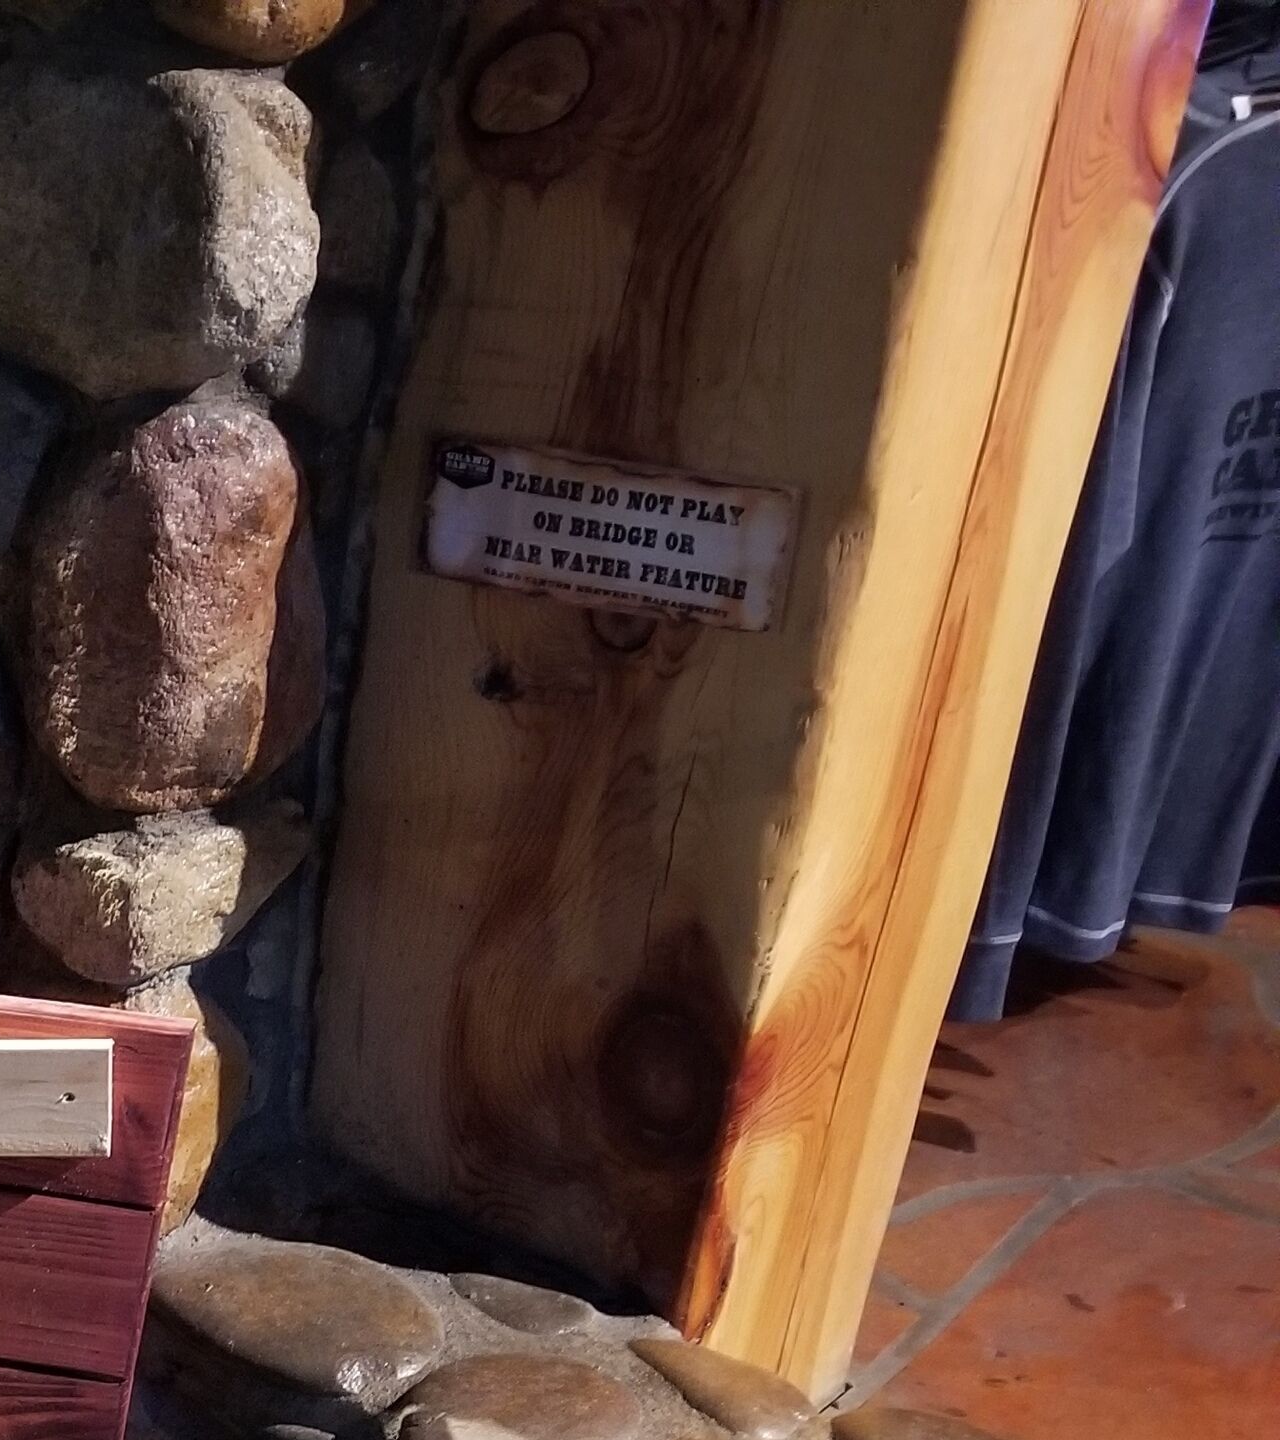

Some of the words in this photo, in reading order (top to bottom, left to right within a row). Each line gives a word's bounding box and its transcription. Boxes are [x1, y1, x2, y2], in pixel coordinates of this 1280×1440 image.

[501, 470, 586, 502] PLEASE
[591, 484, 620, 508] DO
[627, 490, 675, 518] NOT
[680, 497, 746, 527] PLAY
[533, 510, 562, 534] ON
[569, 516, 659, 549] BRIDGE
[665, 532, 696, 556] OR
[484, 535, 542, 566] NEAR
[550, 547, 632, 580] WATER
[639, 562, 748, 601] FEATURE
